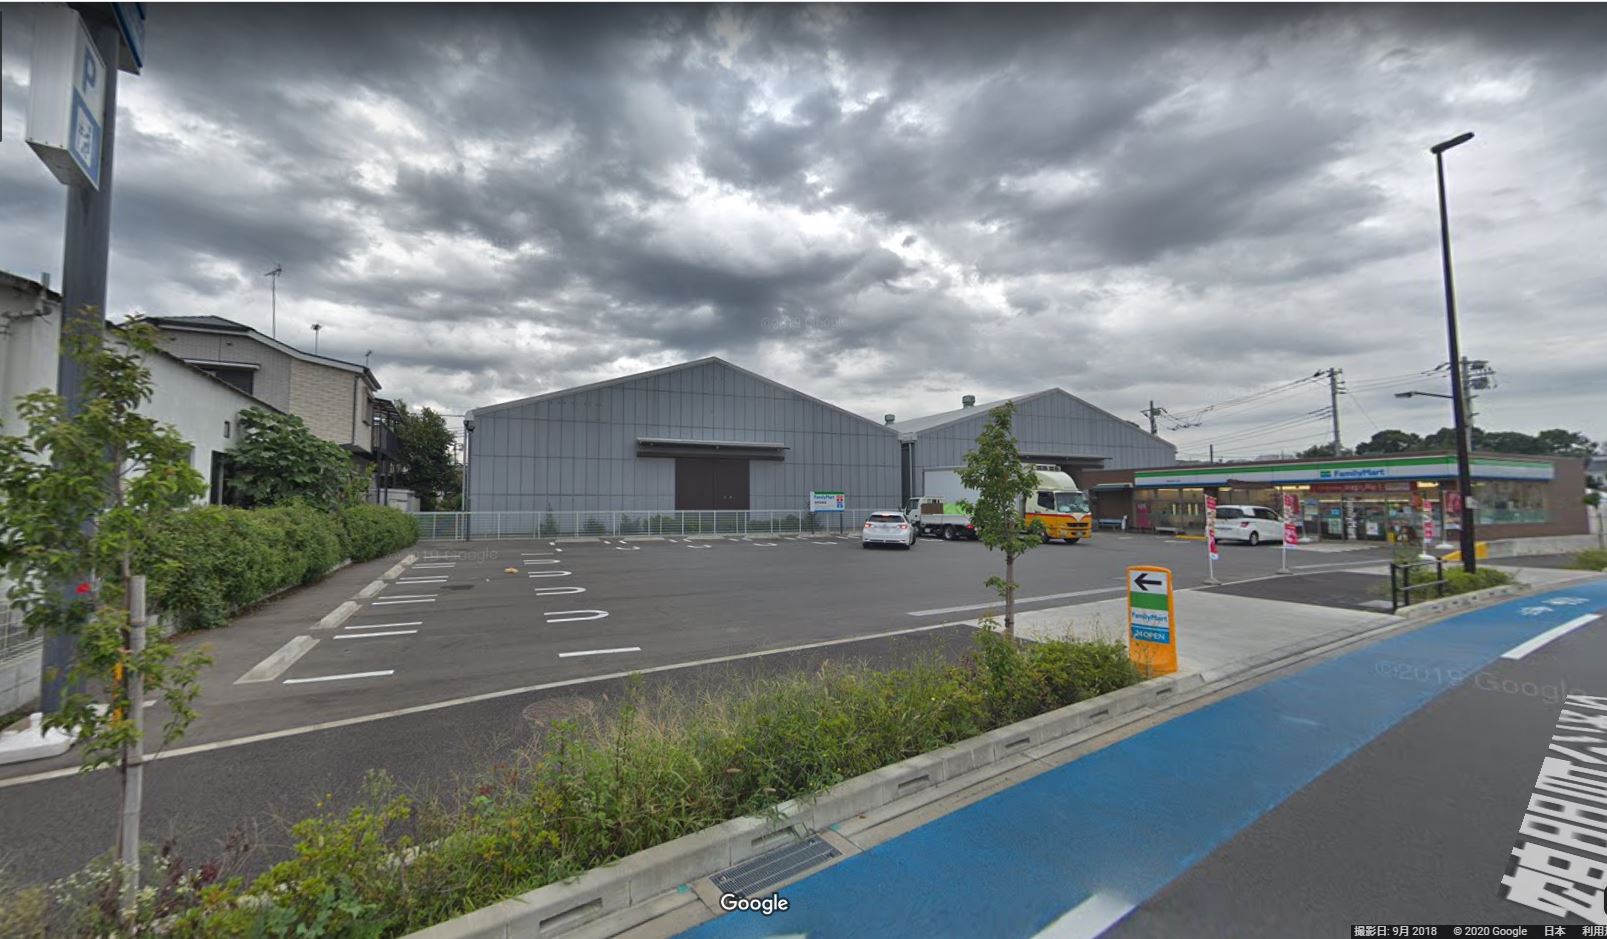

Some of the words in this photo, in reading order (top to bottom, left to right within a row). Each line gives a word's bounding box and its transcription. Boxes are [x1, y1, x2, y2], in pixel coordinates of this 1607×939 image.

[82, 47, 96, 94] P
[1334, 468, 1386, 478] FamilyMart
[1132, 612, 1168, 622] FamilyMart
